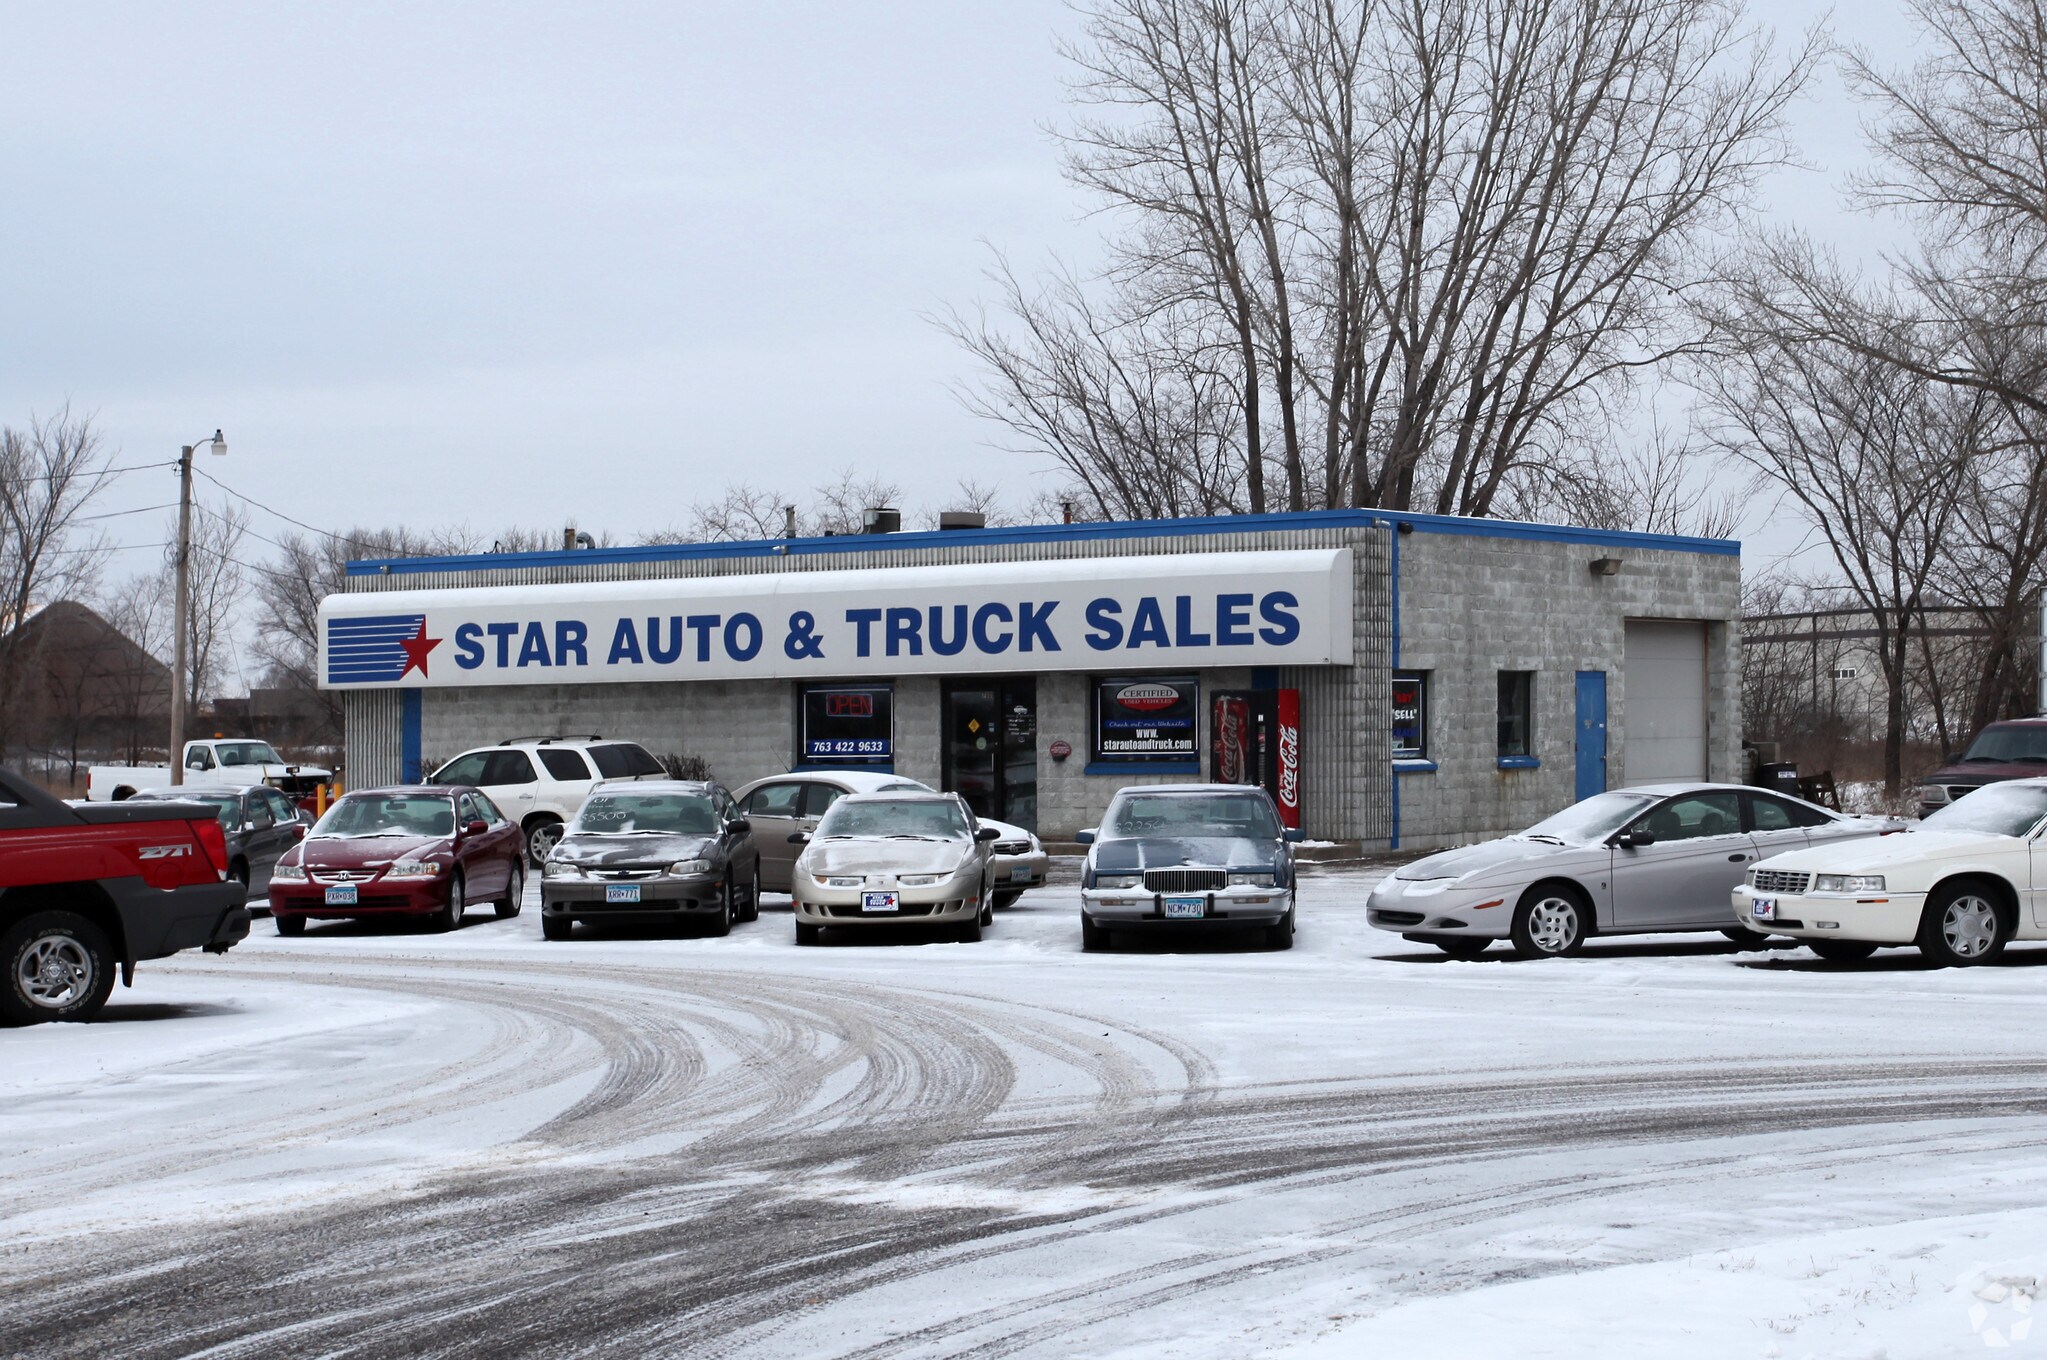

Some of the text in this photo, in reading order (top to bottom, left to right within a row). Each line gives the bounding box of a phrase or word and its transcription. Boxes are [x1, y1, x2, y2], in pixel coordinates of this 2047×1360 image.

[454, 592, 1300, 669] STAR AUTO & TRUCK SALES
[828, 694, 872, 715] OPEN
[814, 742, 883, 752] 763 422 9633
[1104, 739, 1192, 750] starautoandtruck.com
[139, 844, 192, 859] Z71
